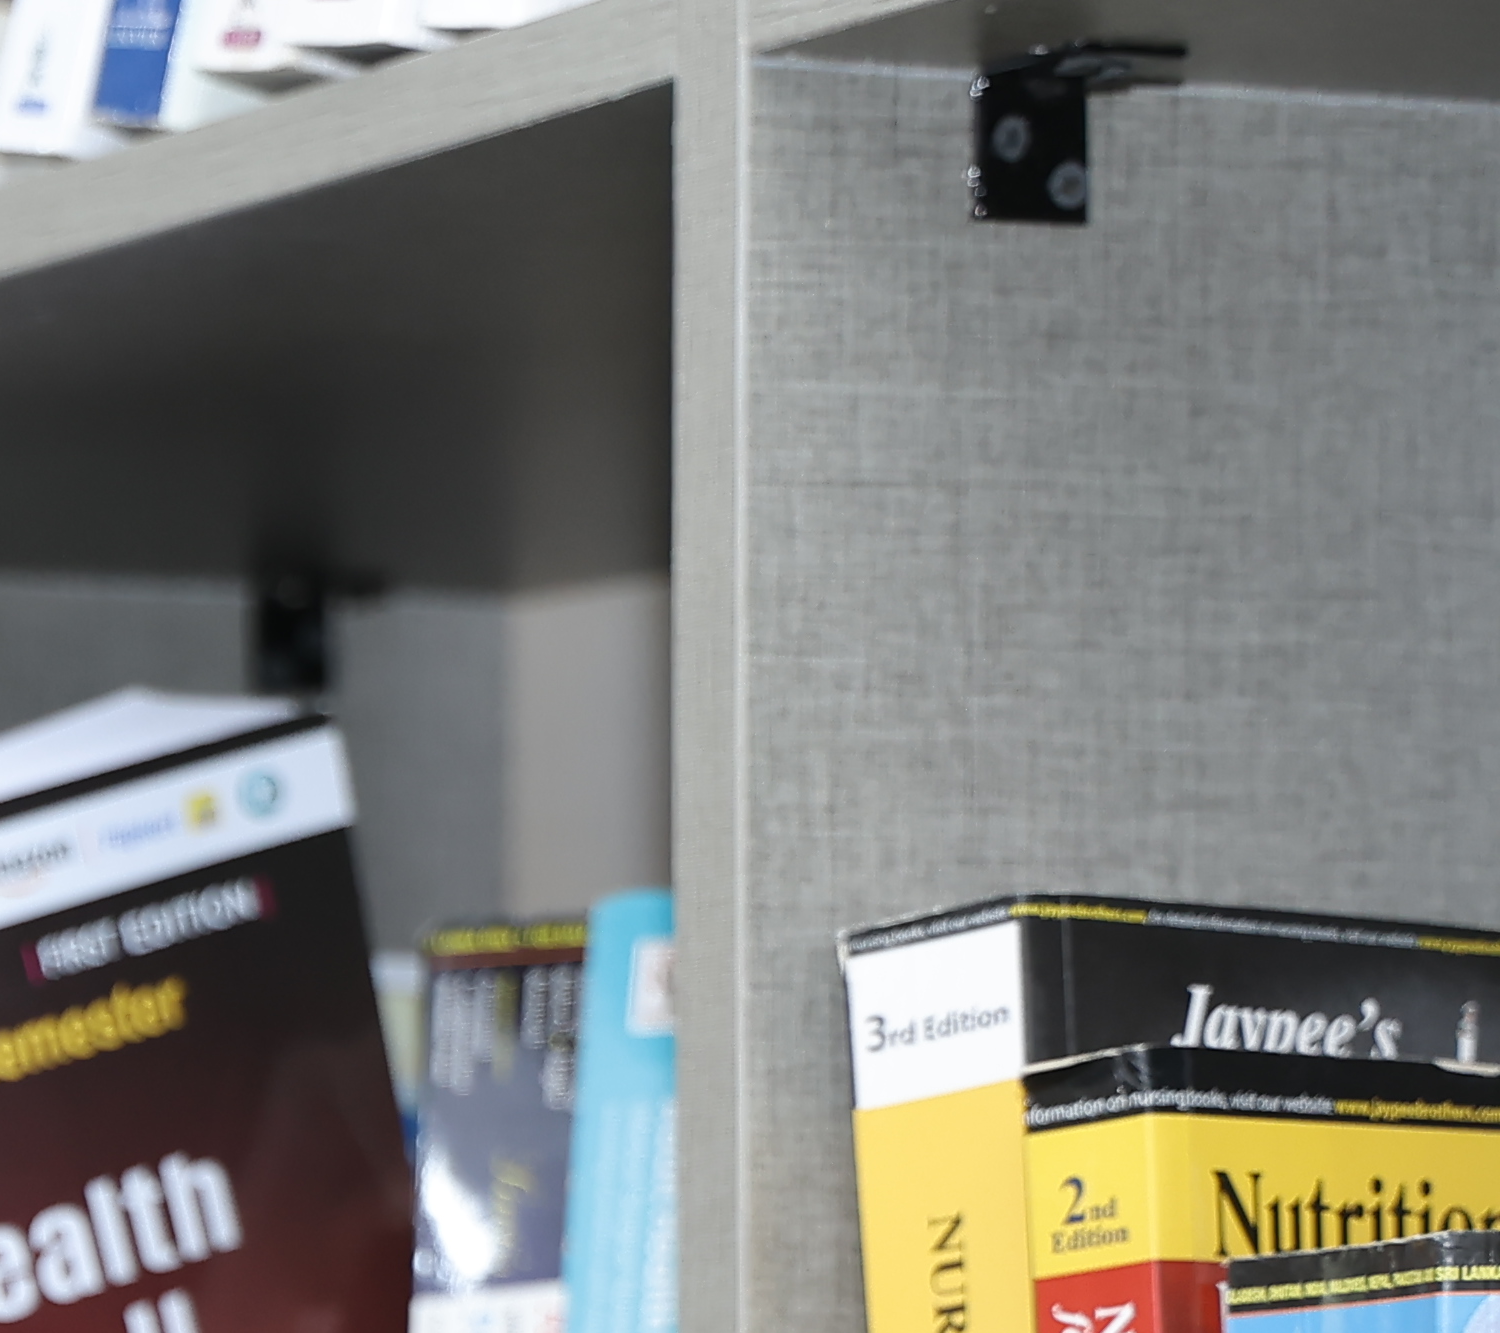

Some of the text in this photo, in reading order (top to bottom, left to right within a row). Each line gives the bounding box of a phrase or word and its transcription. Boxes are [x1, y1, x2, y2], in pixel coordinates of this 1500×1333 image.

[117, 876, 263, 957] EDITION
[864, 1005, 1011, 1053] 3rd Edition
[1060, 1174, 1120, 1227] 2nd
[1050, 1221, 1130, 1254] Edition
